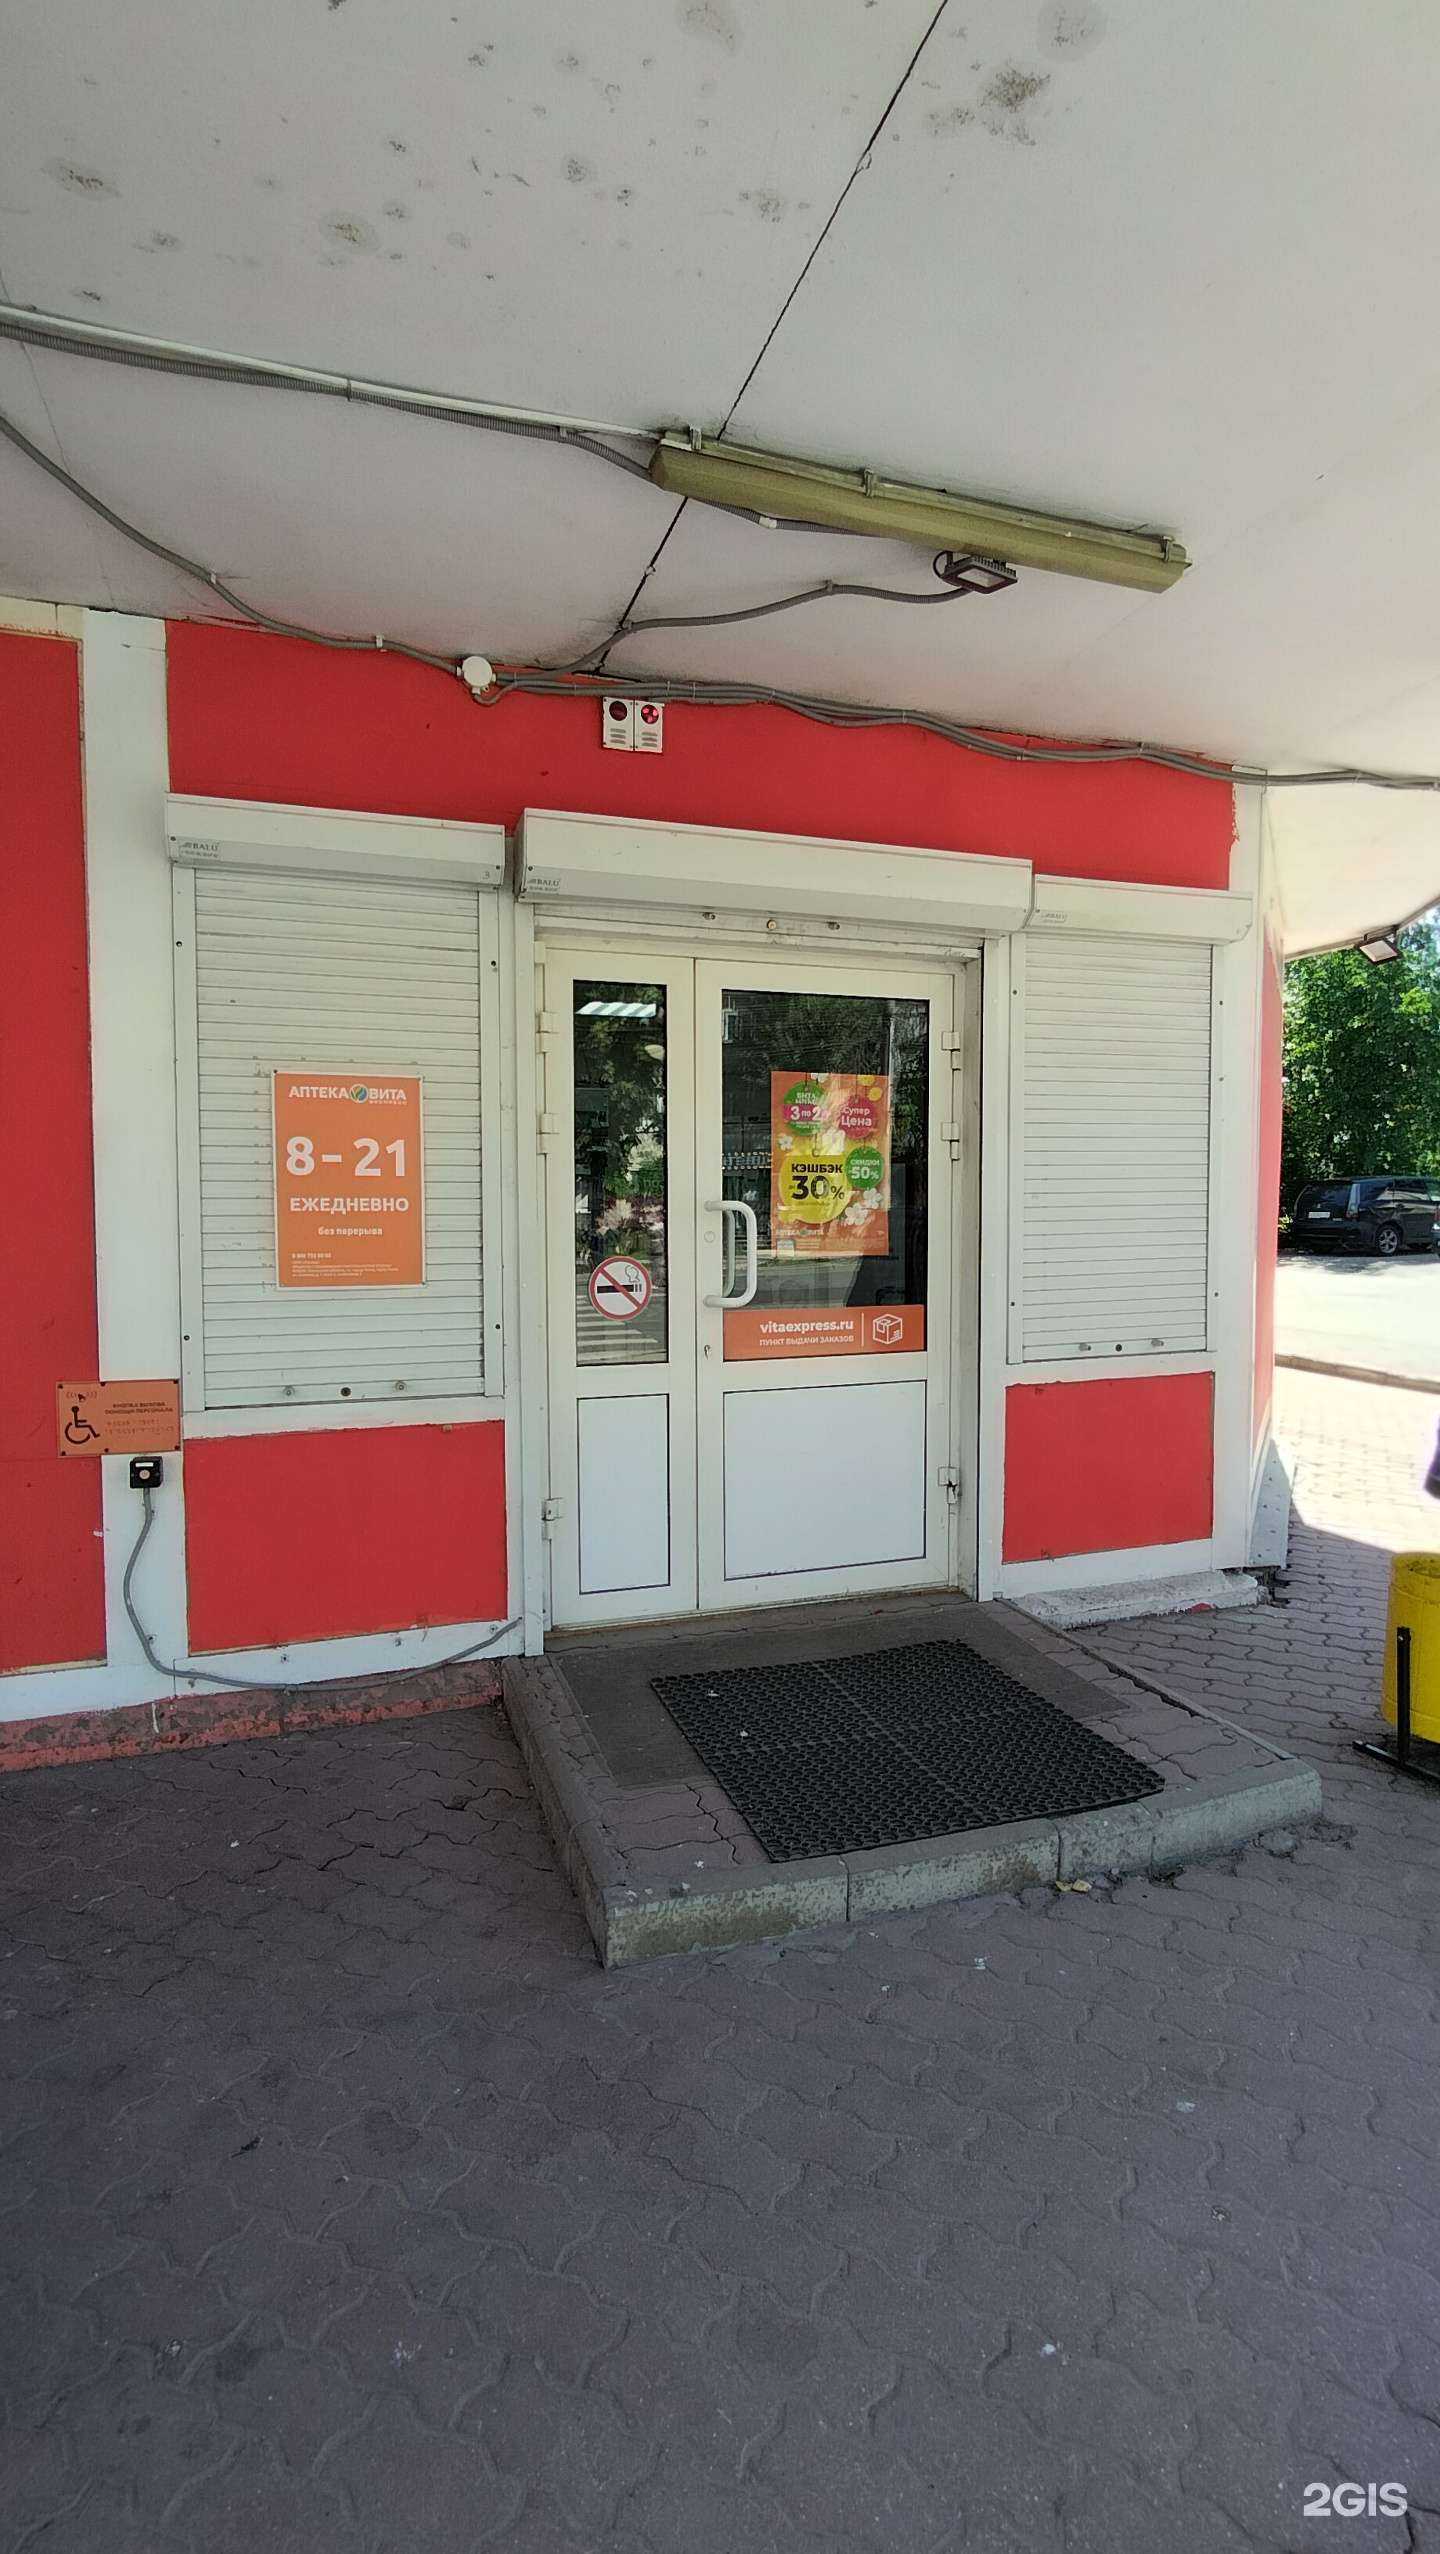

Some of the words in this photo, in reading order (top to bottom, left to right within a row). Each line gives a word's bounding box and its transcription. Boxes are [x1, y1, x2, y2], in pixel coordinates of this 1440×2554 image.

[288, 1085, 350, 1099] АПТЕКА
[368, 1087, 407, 1100] ВИТА
[790, 1105, 801, 1121] 3
[841, 1115, 873, 1127] Цена
[353, 1138, 406, 1177] 21
[791, 1162, 843, 1174] КЭШБЭК
[289, 1198, 409, 1215] ЕЖЕДНЕВНО
[318, 1226, 335, 1236] без
[336, 1228, 383, 1237] перерыва
[760, 1320, 854, 1334] vitaexpress.ru
